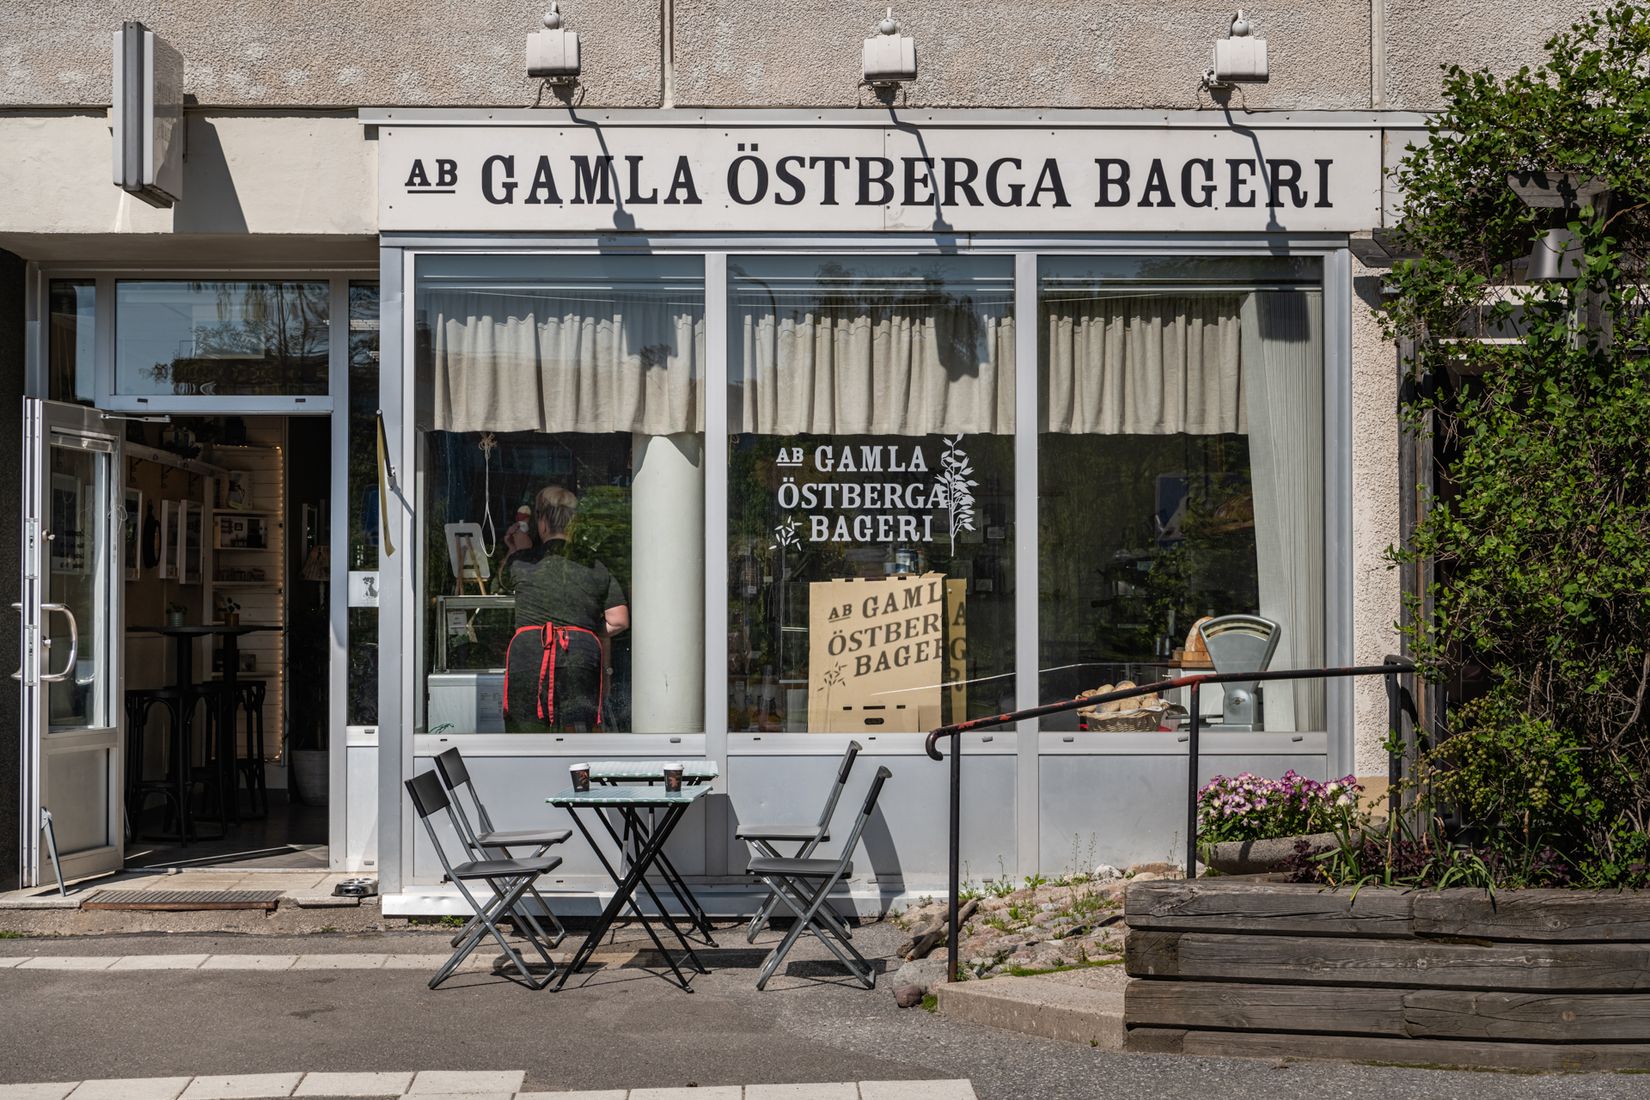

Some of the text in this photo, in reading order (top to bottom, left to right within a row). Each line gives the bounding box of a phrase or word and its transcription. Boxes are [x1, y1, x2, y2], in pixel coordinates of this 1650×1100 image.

[404, 143, 1334, 210] AB GAMLA ÖSTBERGA BAGERI
[776, 445, 929, 473] AB GAMLA
[777, 477, 949, 510] ÖSTBERGA
[809, 515, 933, 543] BAGERI
[828, 603, 854, 620] AB
